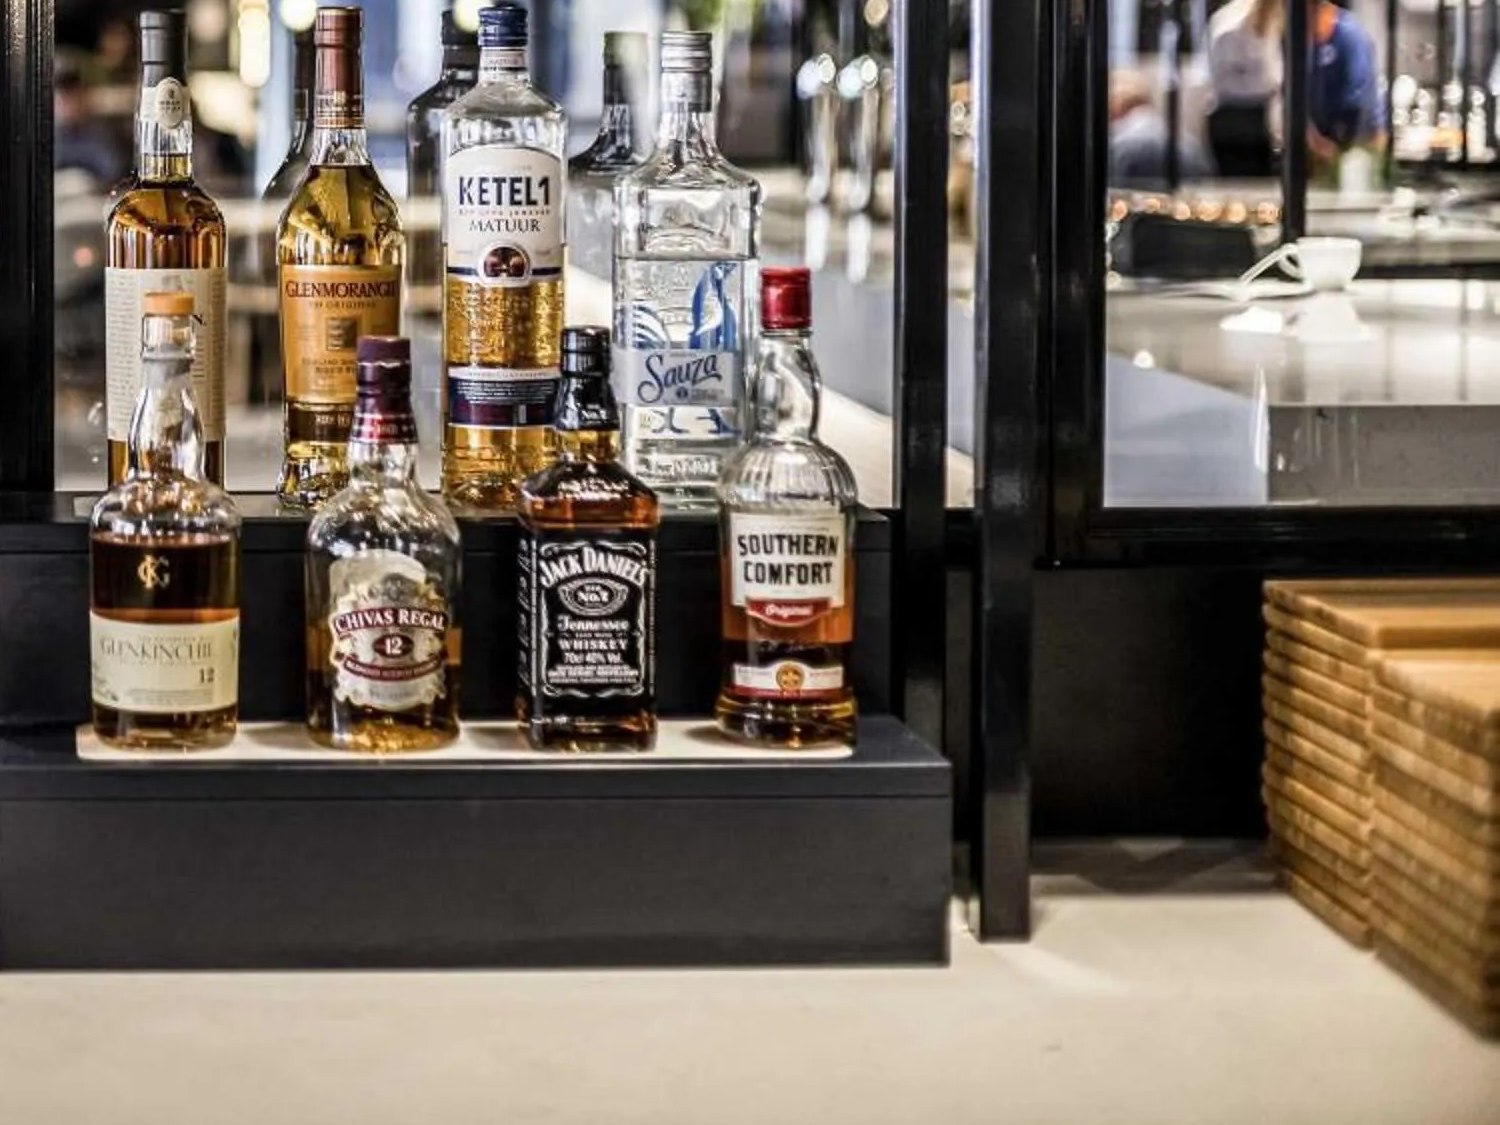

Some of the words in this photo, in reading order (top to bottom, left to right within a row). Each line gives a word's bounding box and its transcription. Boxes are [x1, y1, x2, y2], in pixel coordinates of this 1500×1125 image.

[469, 218, 541, 233] MATUUR
[637, 353, 722, 403] Sauza
[737, 533, 839, 557] SOUTHERN
[539, 554, 583, 587] JACK
[582, 546, 647, 586] DANIEL'S
[743, 562, 833, 585] COMFORT
[335, 610, 394, 632] CHIVAS
[398, 608, 445, 629] REGAL
[384, 637, 403, 655] 12
[558, 639, 629, 650] WHISKEY
[199, 668, 215, 684] 12
